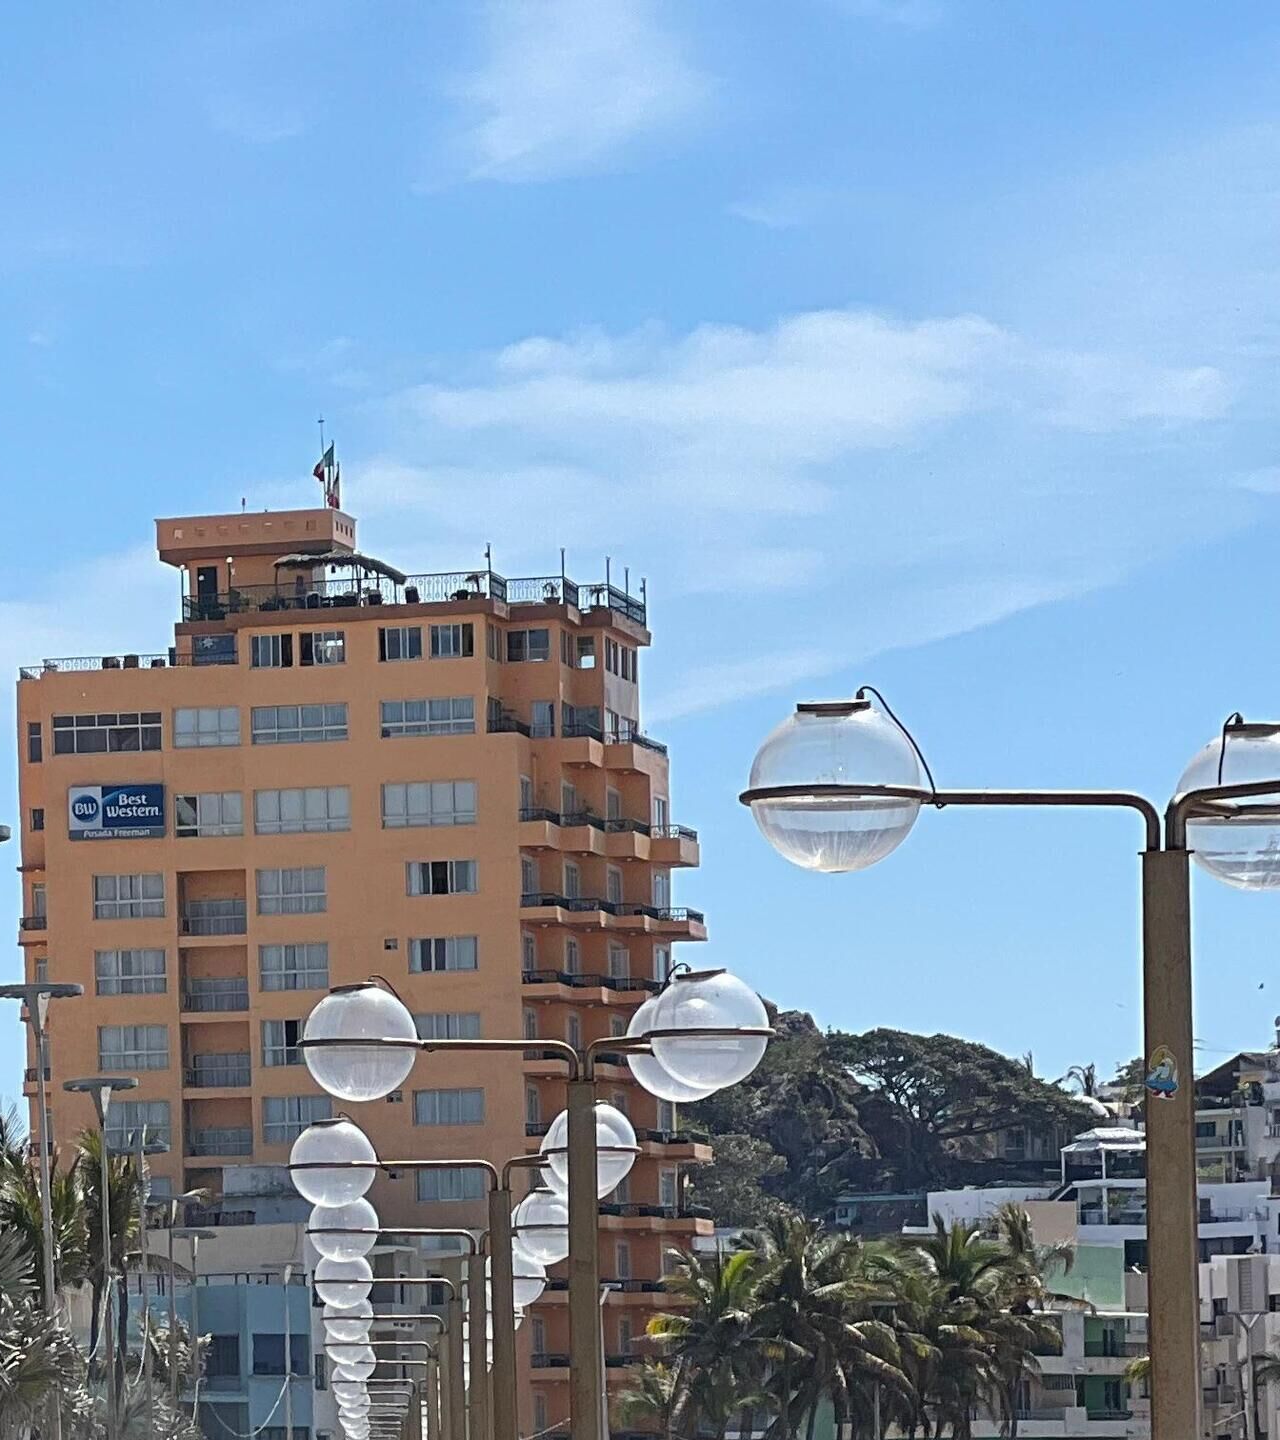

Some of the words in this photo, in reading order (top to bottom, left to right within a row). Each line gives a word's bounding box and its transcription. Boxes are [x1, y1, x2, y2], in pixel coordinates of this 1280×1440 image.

[118, 794, 147, 806] Best
[75, 803, 97, 815] BW
[106, 806, 159, 818] Western
